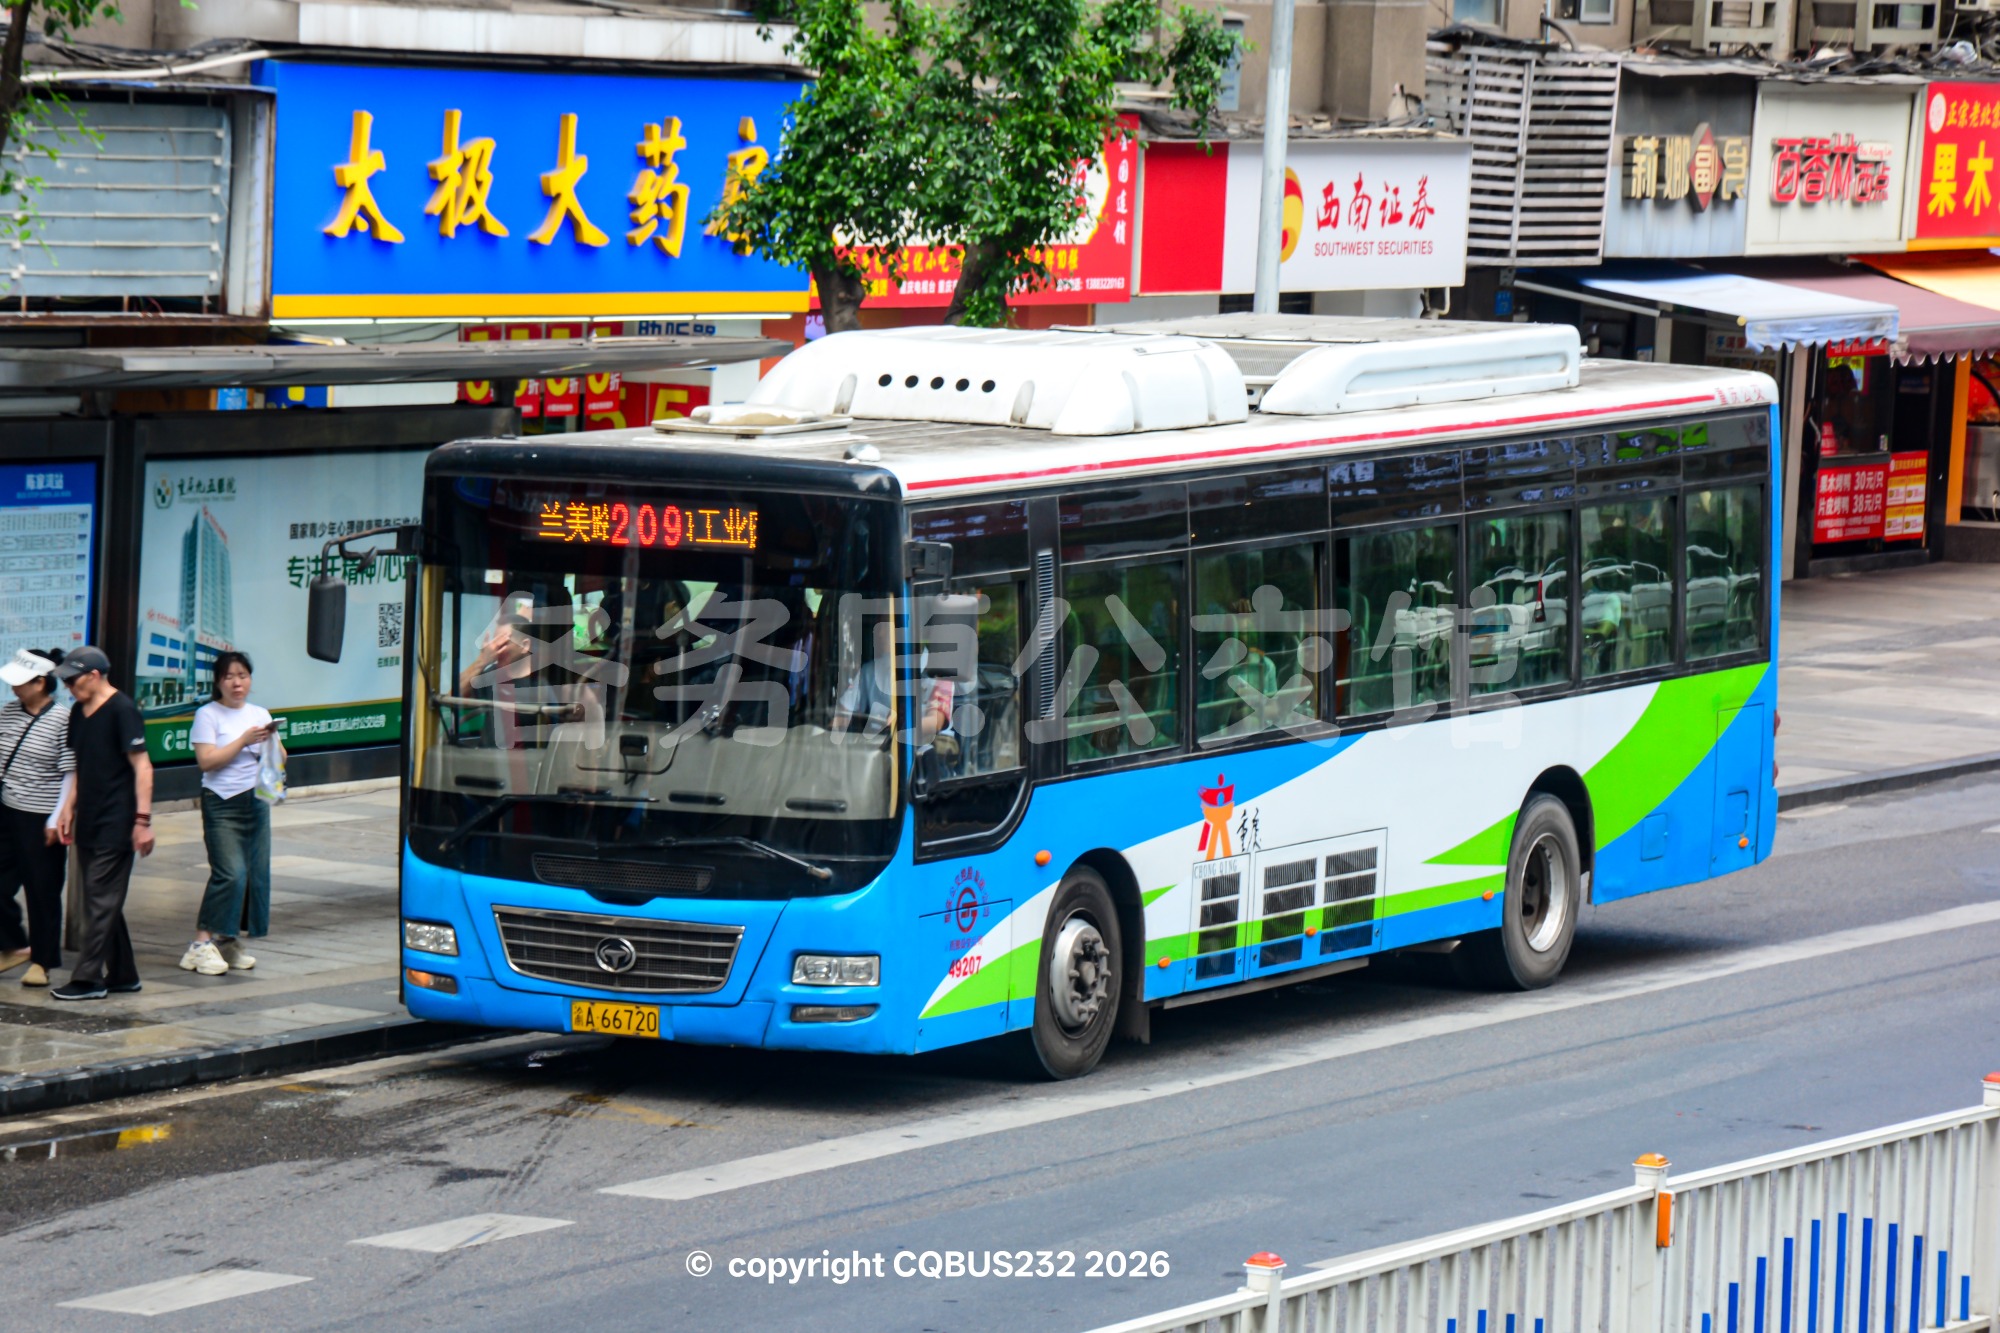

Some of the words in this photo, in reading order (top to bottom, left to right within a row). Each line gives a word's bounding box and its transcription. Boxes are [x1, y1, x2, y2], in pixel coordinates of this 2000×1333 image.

[1769, 133, 1857, 203] 百香林
[1316, 172, 1435, 232] 西南证券
[1314, 241, 1374, 256] SOUTHWEST
[1378, 240, 1433, 255] SECURITIES
[611, 503, 682, 546] 209
[1195, 864, 1217, 879] CHONG
[1220, 860, 1238, 875] QING
[948, 955, 982, 978] 49207
